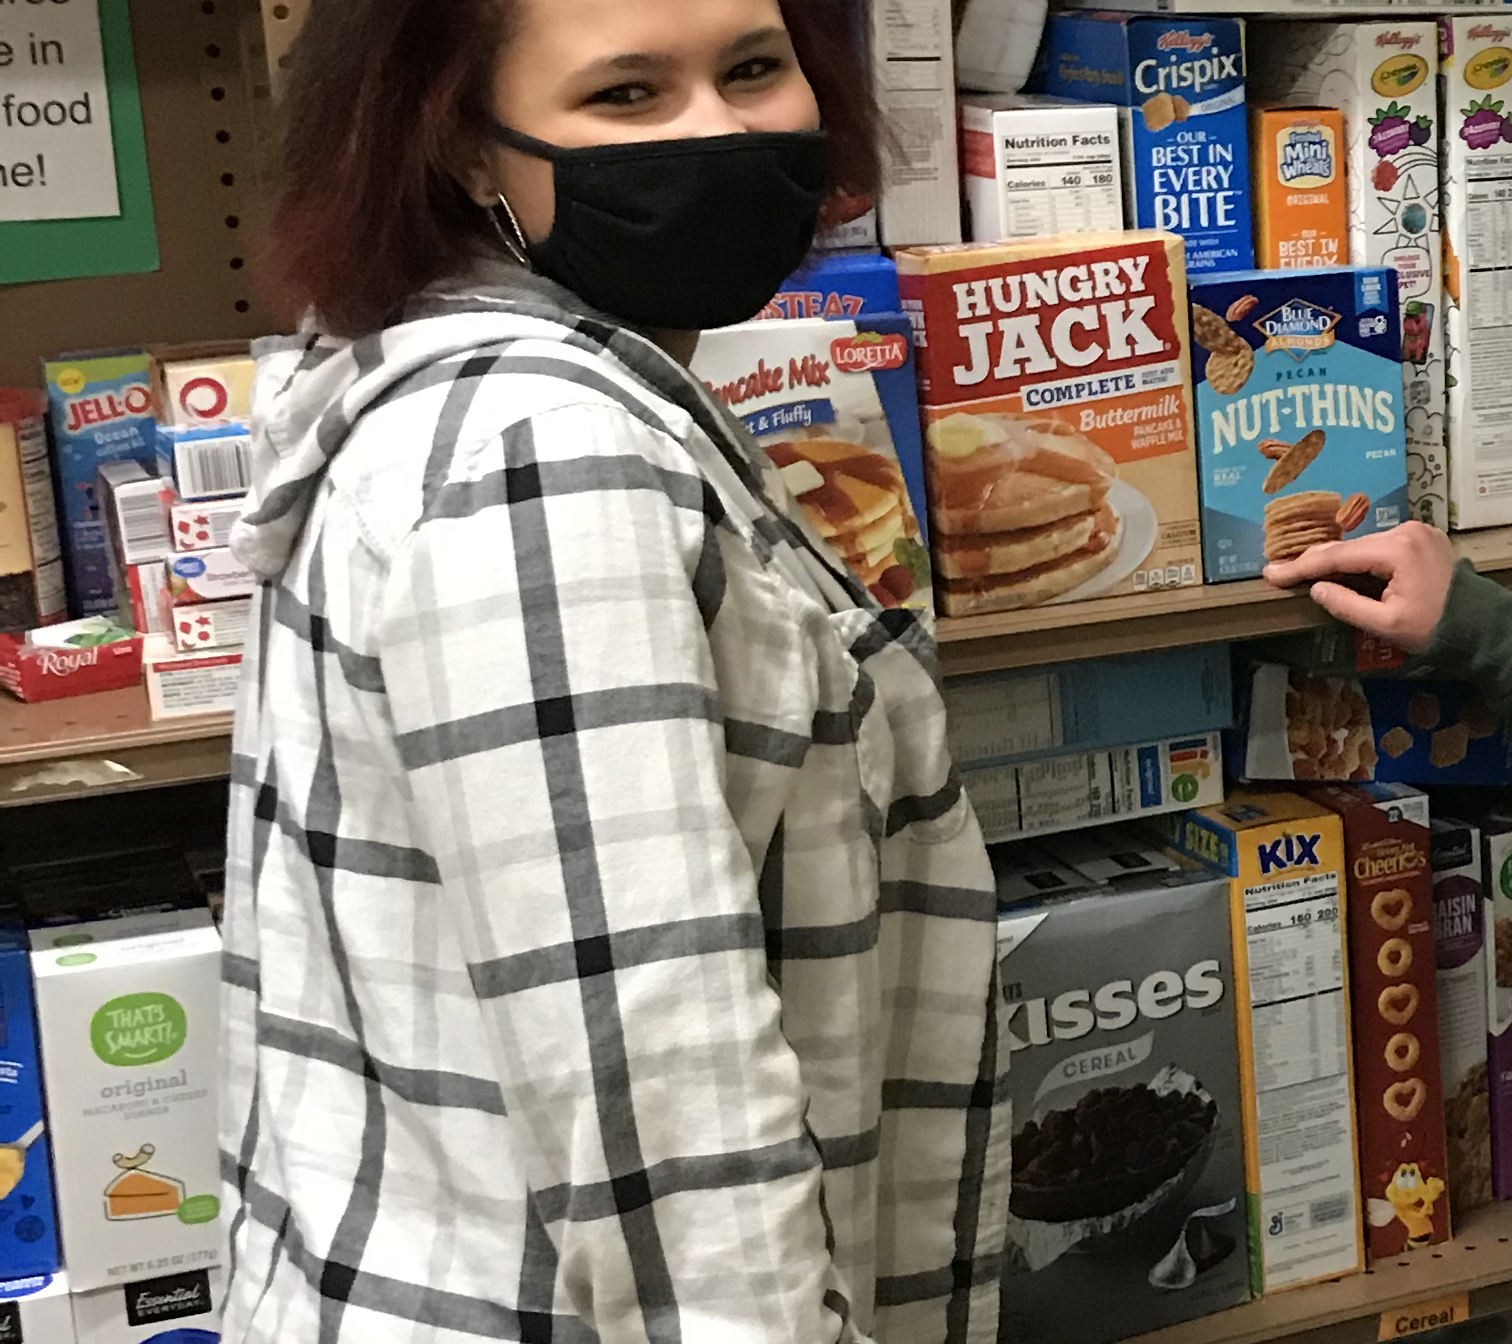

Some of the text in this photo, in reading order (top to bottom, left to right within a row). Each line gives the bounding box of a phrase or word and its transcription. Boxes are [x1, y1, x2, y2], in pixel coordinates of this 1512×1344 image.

[29, 33, 64, 65] in
[1157, 29, 1215, 52] Kellogg's
[1134, 46, 1239, 94] Crispix
[2, 92, 91, 128] food
[1005, 133, 1112, 149] Nutrition Facts
[1176, 131, 1207, 143] OUR
[1151, 143, 1234, 168] BEST IN
[1285, 141, 1328, 164] Mini
[1466, 157, 1498, 166] Nutrition
[1007, 179, 1046, 190] Calories
[1060, 175, 1082, 186] 140
[1153, 165, 1234, 194] EVERY
[1281, 160, 1332, 182] Wheats
[1154, 191, 1238, 231] BITE
[1192, 248, 1239, 260] AMERICAN
[1279, 238, 1339, 257] BEST IN
[952, 255, 1150, 320] HUNGRY
[1265, 314, 1333, 337] DIAMOND
[1281, 306, 1315, 322] BLUE
[835, 342, 904, 365] LORETTA
[952, 294, 1166, 388] JACK
[1270, 336, 1332, 349] ALMONDS
[789, 353, 832, 390] Mix
[1276, 367, 1329, 382] PECAN
[1024, 374, 1136, 408] COMPLETE
[758, 404, 813, 432] & Fluffy
[1079, 396, 1181, 433] Buttermilk
[1211, 382, 1396, 456] NUT-THINS
[1130, 429, 1185, 451] WAFFLE MIX
[1133, 421, 1175, 437] PANCAKE
[38, 646, 100, 677] Royal
[1168, 737, 1212, 803] life
[1256, 833, 1322, 876] KIX
[1353, 848, 1427, 880] Cheerios
[1244, 873, 1337, 897] Nutrition Facts
[1061, 1047, 1138, 1081] CEREAL
[100, 1068, 189, 1099] original
[136, 1282, 201, 1308] Essential
[1393, 1305, 1456, 1336] Cereal
